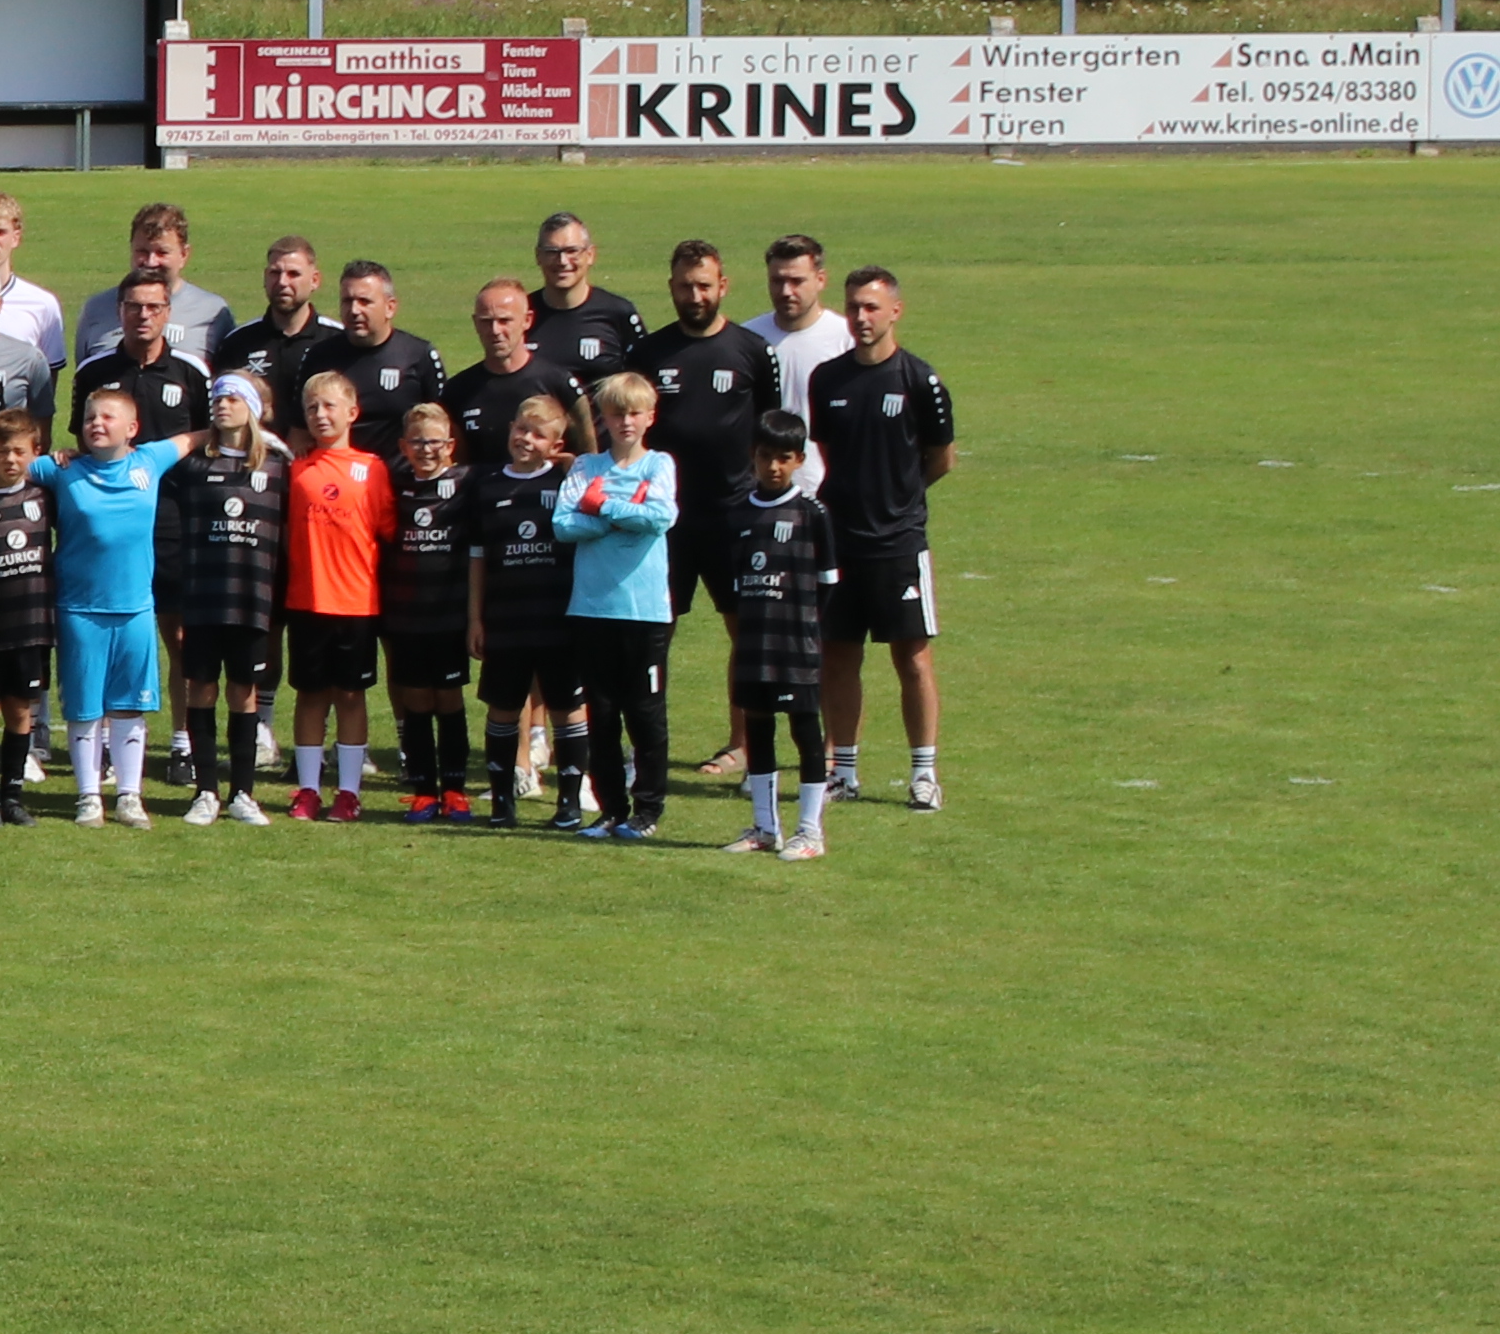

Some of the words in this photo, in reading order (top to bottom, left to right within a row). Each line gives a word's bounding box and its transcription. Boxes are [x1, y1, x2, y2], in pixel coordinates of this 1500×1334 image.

[346, 48, 462, 70] matthias
[502, 43, 548, 57] Fenster
[674, 48, 722, 74] ihr
[743, 44, 919, 74] schreiner
[982, 43, 1180, 73] Wintergärten
[1321, 42, 1420, 66] a.Main
[502, 63, 536, 78] Türen
[502, 83, 542, 97] Möbel
[545, 86, 571, 98] zum
[979, 79, 1089, 103] Fenster
[1216, 82, 1253, 102] Tel.
[1263, 80, 1417, 103] 09524/83380
[502, 103, 553, 118] Wohnen
[626, 82, 916, 138] KRINES
[980, 112, 1065, 136] Türen
[1158, 112, 1418, 134] www.krines-online.de
[166, 131, 203, 142] 97475
[206, 130, 229, 141] Zeil
[234, 133, 253, 141] am
[257, 131, 289, 143] Main
[302, 129, 390, 144] Grabengärten
[394, 130, 398, 140] 1
[411, 130, 430, 141] Tel.
[434, 129, 504, 143] 09524/241
[516, 129, 538, 140] Fax
[543, 129, 571, 140] 5691
[404, 527, 452, 541] ZURICH
[506, 541, 553, 556] ZURICH
[648, 665, 658, 692] 1
